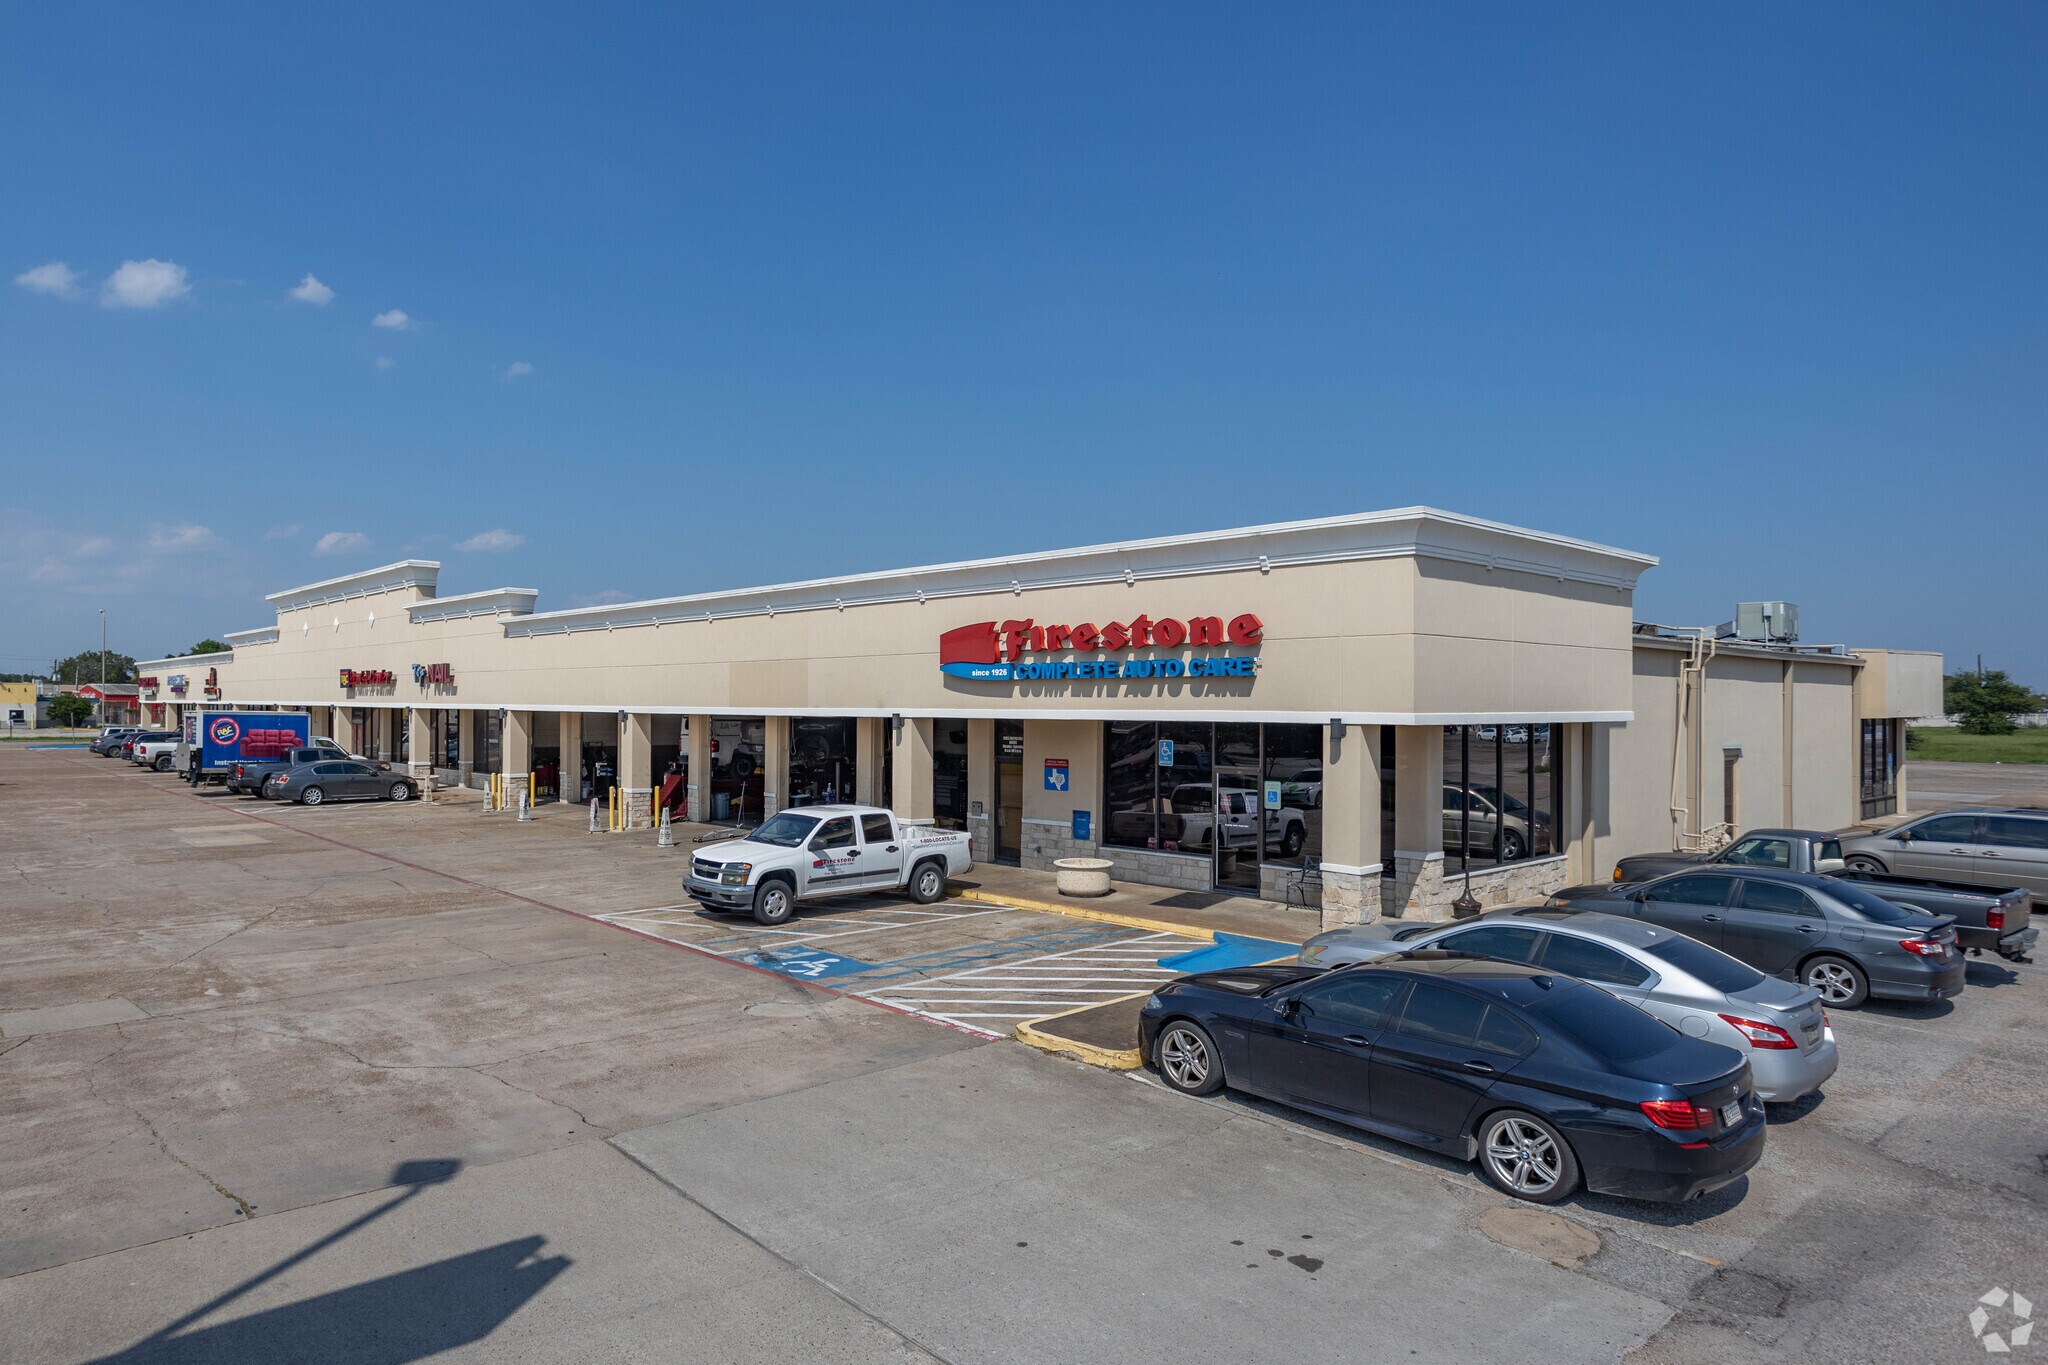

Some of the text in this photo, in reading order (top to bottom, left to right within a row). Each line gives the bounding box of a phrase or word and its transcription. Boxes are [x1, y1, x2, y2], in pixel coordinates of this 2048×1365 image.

[1001, 613, 1263, 662] Firestone
[427, 663, 451, 683] NAIL
[971, 668, 1008, 677] since 1926
[1016, 656, 1256, 680] COMPLETE AUTO CARE
[216, 725, 233, 736] RAC
